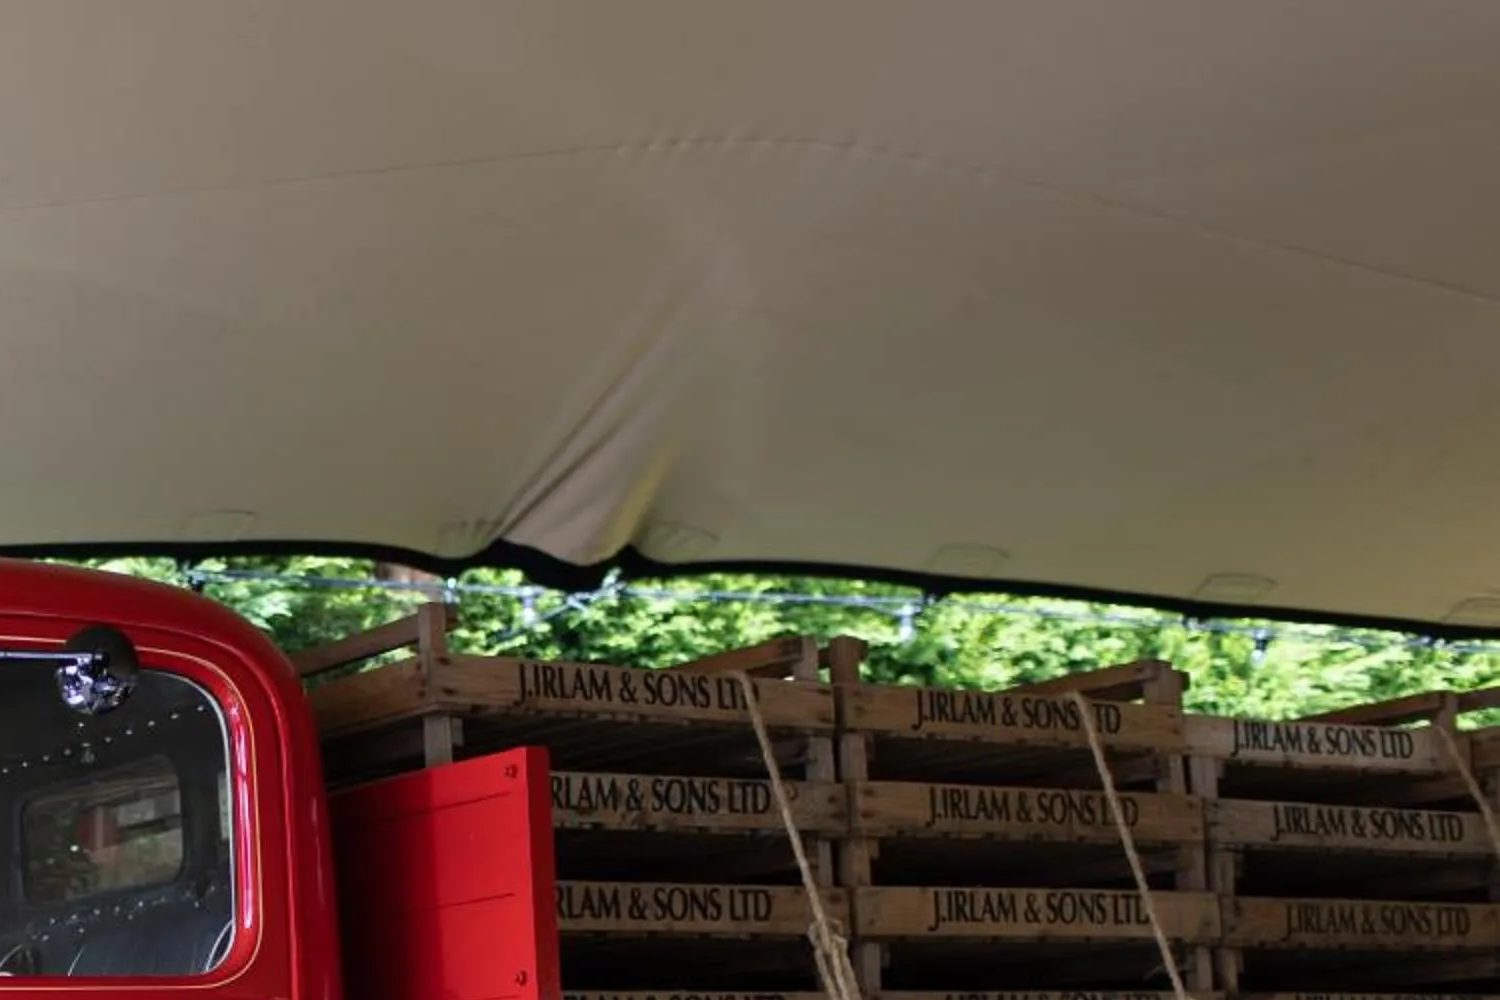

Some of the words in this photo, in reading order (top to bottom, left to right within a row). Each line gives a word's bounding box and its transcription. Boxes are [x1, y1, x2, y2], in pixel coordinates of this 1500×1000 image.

[517, 664, 612, 705] J.IRLAM
[619, 671, 638, 704] &
[644, 673, 711, 709] SONS
[913, 690, 996, 731] J.IRLAM
[1001, 696, 1017, 727] &
[1023, 698, 1080, 731] SONS
[1091, 703, 1122, 735] TD
[1308, 725, 1322, 753] &
[1325, 727, 1377, 758] SONS
[1381, 729, 1413, 759] LTD
[551, 776, 618, 812] RLAM
[627, 779, 644, 811] &
[652, 778, 720, 814] SONS
[728, 781, 771, 815] LTD
[926, 786, 1010, 827] J.IRLAM
[1016, 791, 1033, 822] &
[1036, 792, 1097, 826] SONS
[1101, 797, 1139, 829] LD
[1351, 810, 1367, 837] &
[1371, 810, 1425, 840] SONS
[1428, 813, 1464, 842] LTD
[555, 885, 621, 921] RLAM
[628, 887, 647, 921] &
[654, 887, 722, 922] SONS
[729, 889, 773, 922] LTD
[928, 890, 1018, 932] J.IRLAM
[1024, 894, 1040, 923] &
[1045, 893, 1106, 925] SONS
[1361, 907, 1375, 935] &
[1380, 906, 1432, 937] SONS
[1437, 906, 1471, 937] LTD
